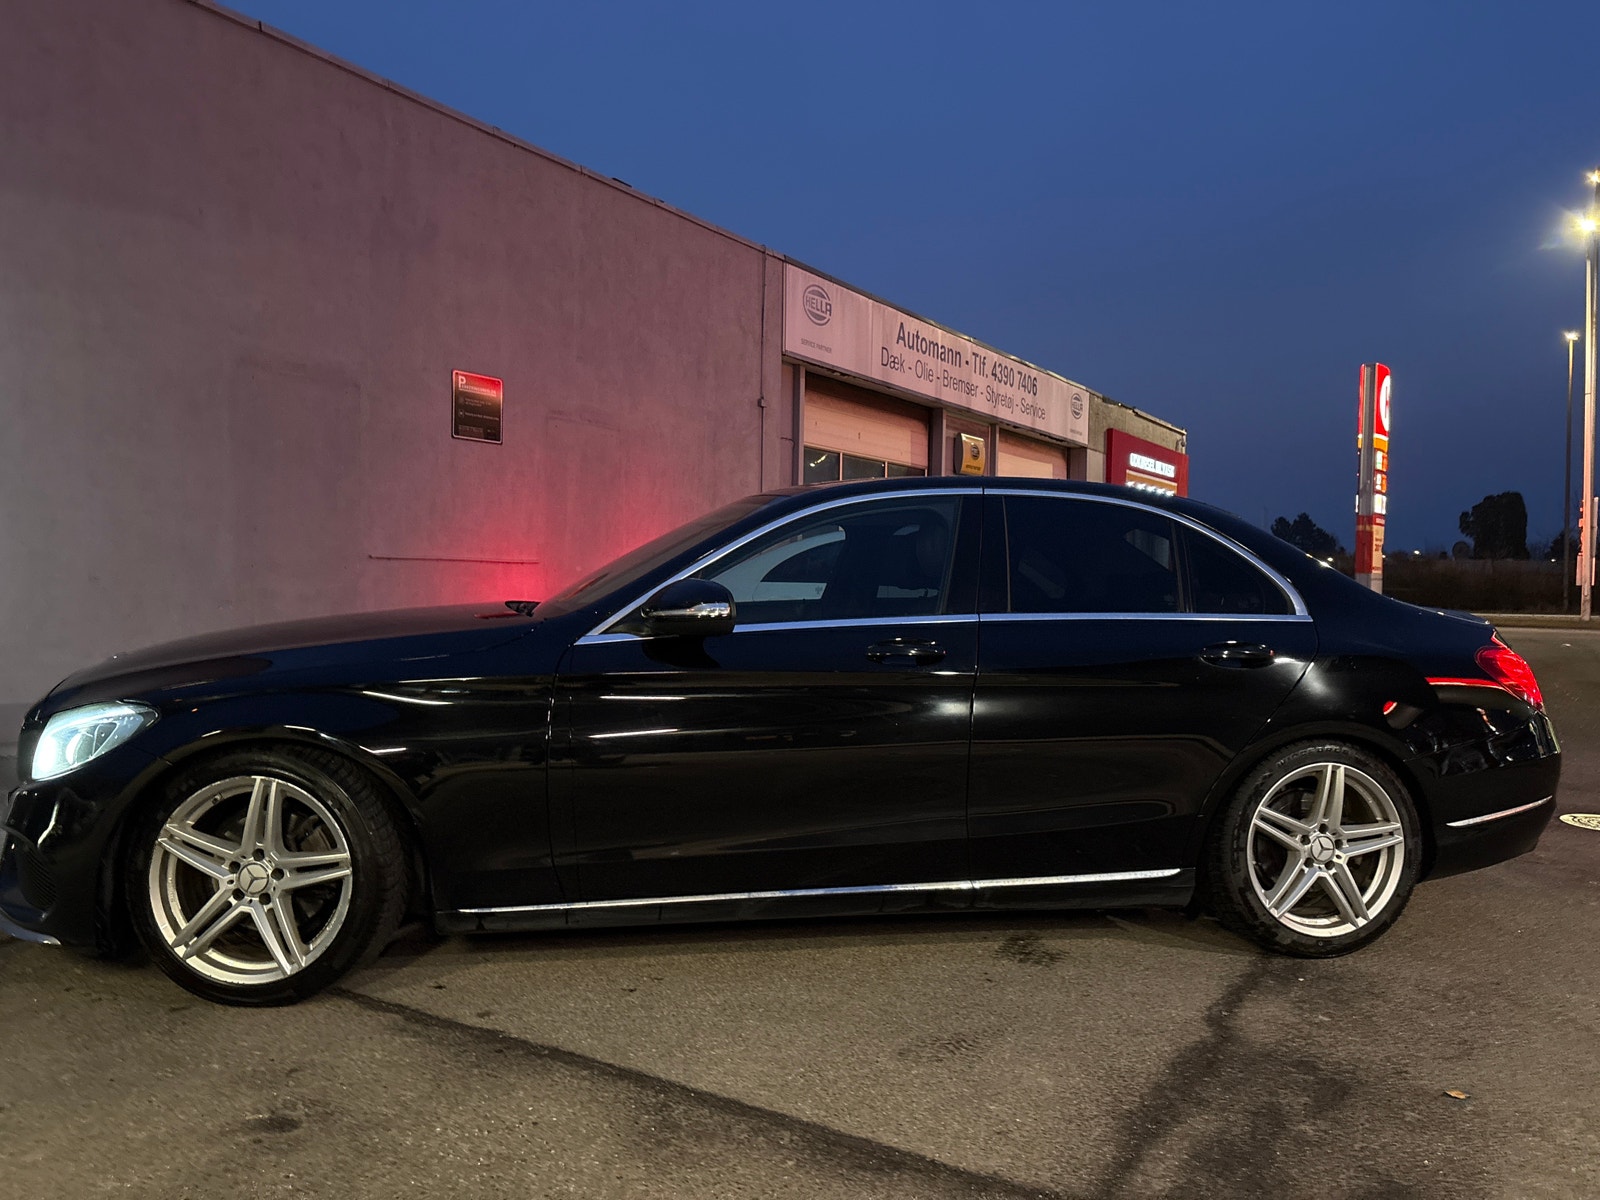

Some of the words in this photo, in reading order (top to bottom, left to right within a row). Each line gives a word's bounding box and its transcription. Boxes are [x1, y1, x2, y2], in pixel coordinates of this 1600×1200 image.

[805, 295, 832, 317] HELLA
[881, 346, 905, 373] Dæk
[915, 359, 934, 382] Olie
[943, 369, 978, 398] Bremser
[986, 385, 1015, 414] Styretøj
[1020, 398, 1046, 420] Service
[896, 322, 962, 368] Automann
[972, 352, 988, 378] Tlf.
[991, 361, 1015, 388] 4390
[1017, 371, 1038, 396] 7406
